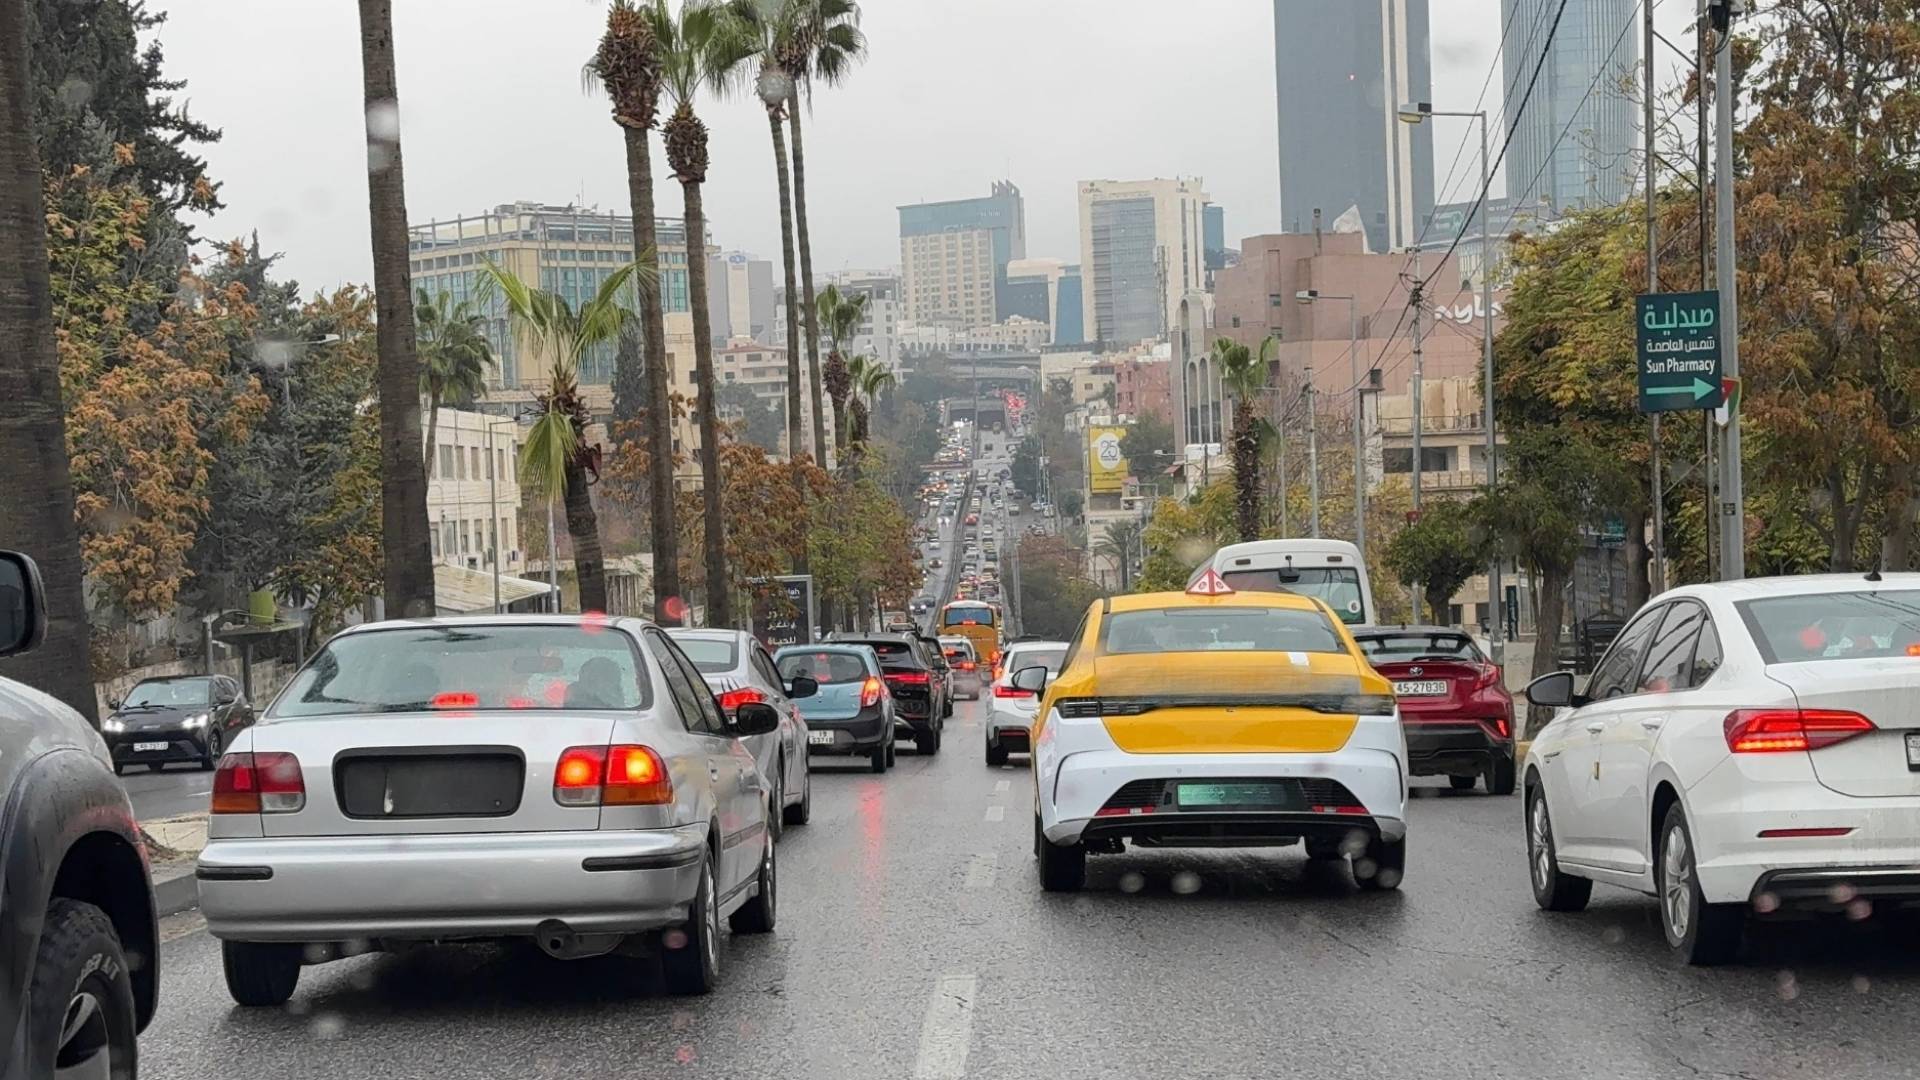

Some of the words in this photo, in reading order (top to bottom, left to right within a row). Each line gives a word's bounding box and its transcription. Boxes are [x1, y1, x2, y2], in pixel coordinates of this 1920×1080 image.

[1644, 302, 1714, 336] صيدلية
[1646, 339, 1684, 353] العاصمة
[1684, 336, 1715, 352] شمس
[1646, 359, 1665, 374] Sun
[1666, 357, 1716, 375] Pharmacy
[1101, 440, 1118, 458] 25
